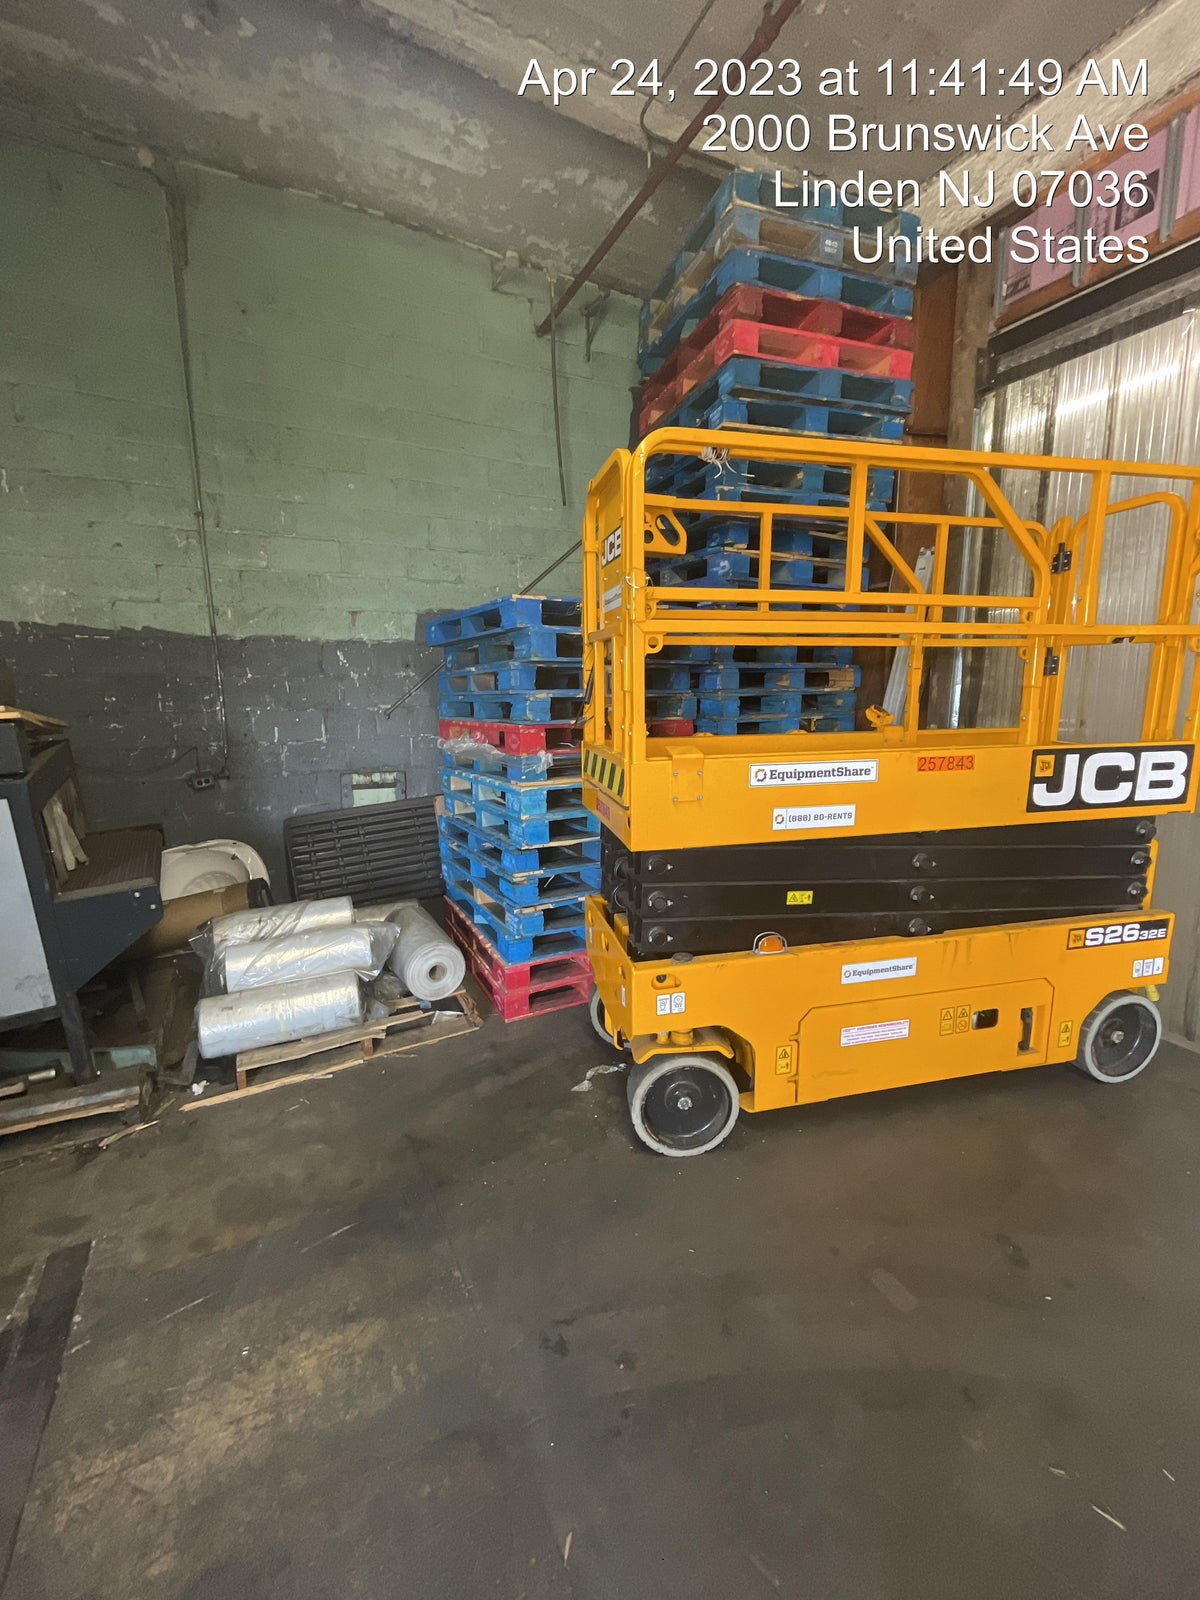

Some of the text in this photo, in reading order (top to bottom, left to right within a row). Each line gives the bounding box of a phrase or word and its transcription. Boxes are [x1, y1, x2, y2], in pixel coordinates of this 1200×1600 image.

[917, 755, 975, 772] 257843
[768, 766, 872, 782] EquipmentShare
[1032, 750, 1188, 807] JCB
[788, 814, 811, 823] (888)
[852, 964, 913, 977] EquipmentShare
